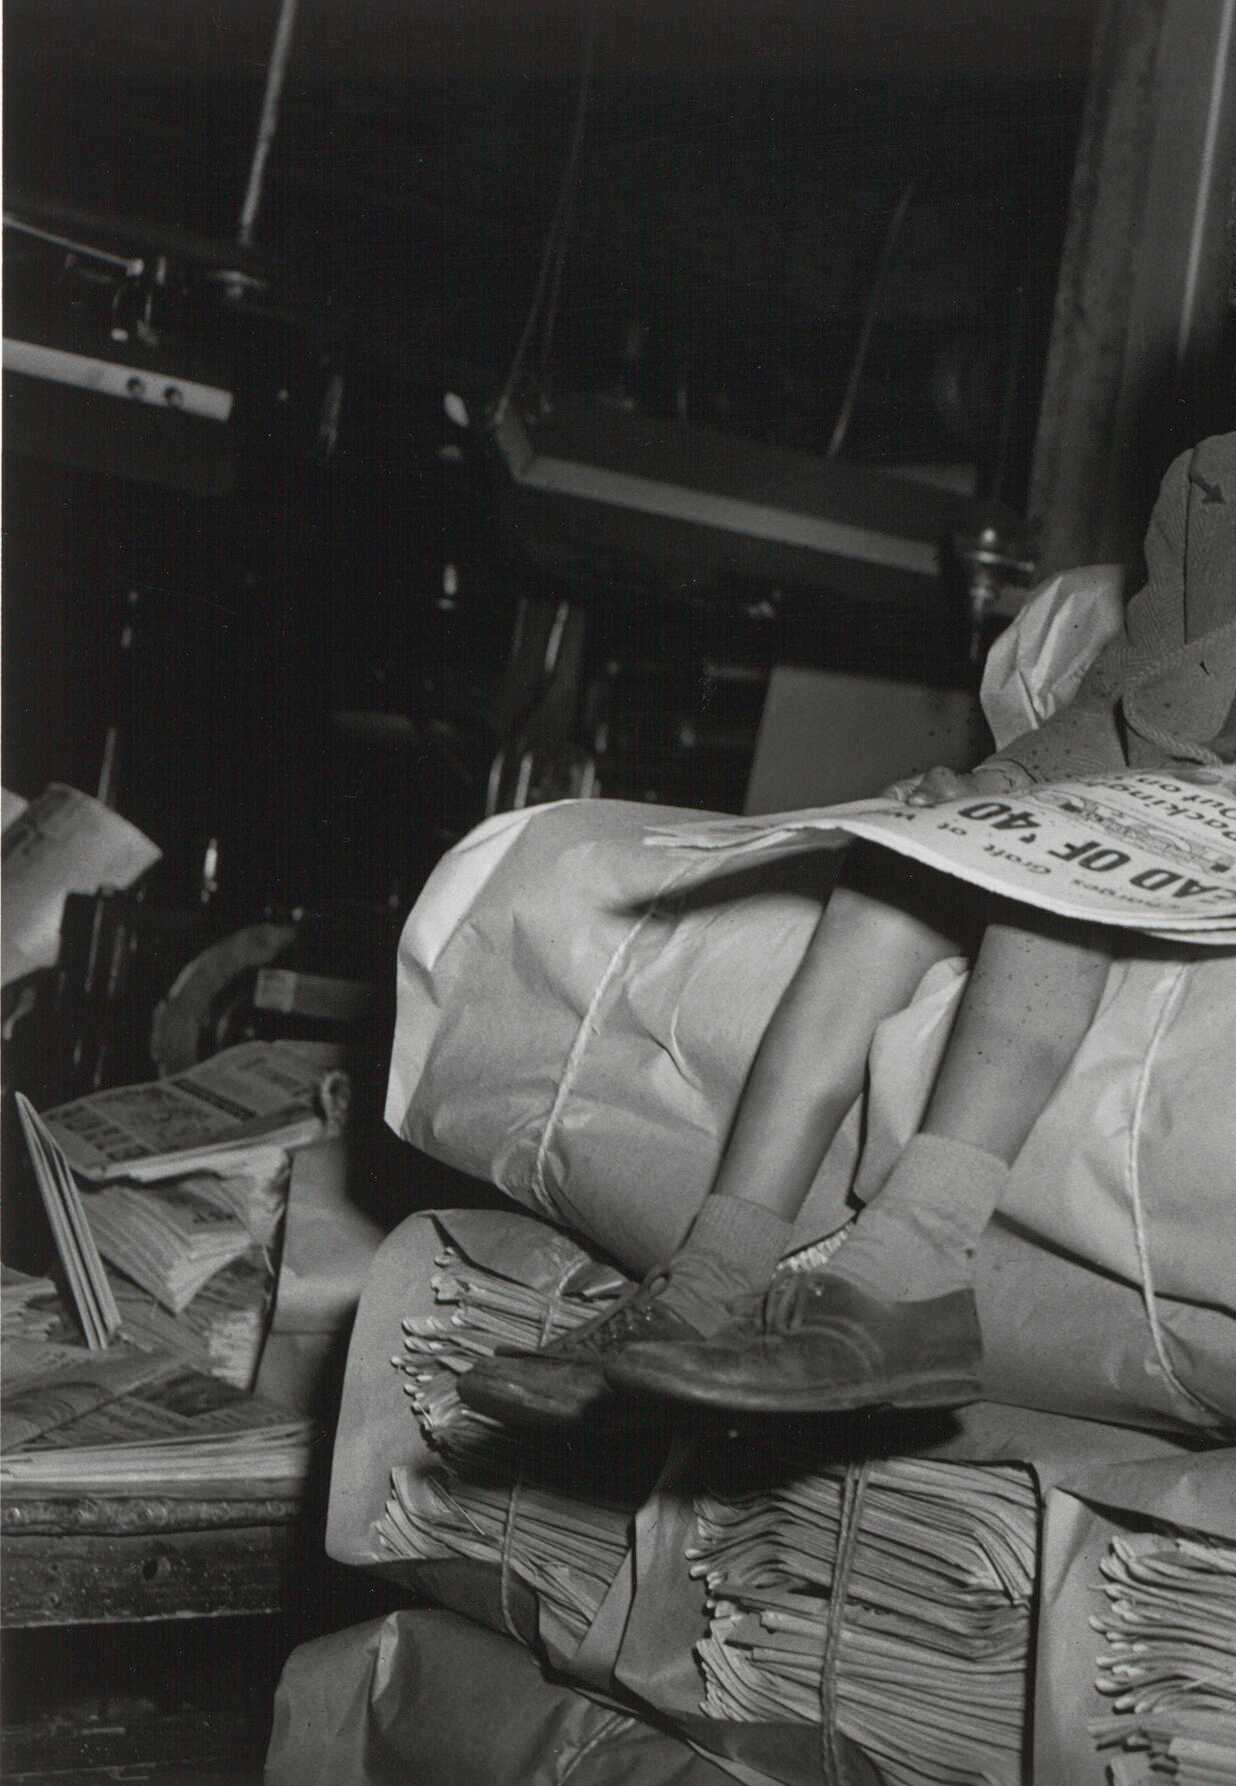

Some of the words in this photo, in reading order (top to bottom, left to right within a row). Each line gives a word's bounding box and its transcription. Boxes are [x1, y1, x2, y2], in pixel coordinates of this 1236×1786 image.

[957, 802, 1041, 844] '40
[982, 844, 1052, 875] Graft
[1047, 840, 1131, 873] OF
